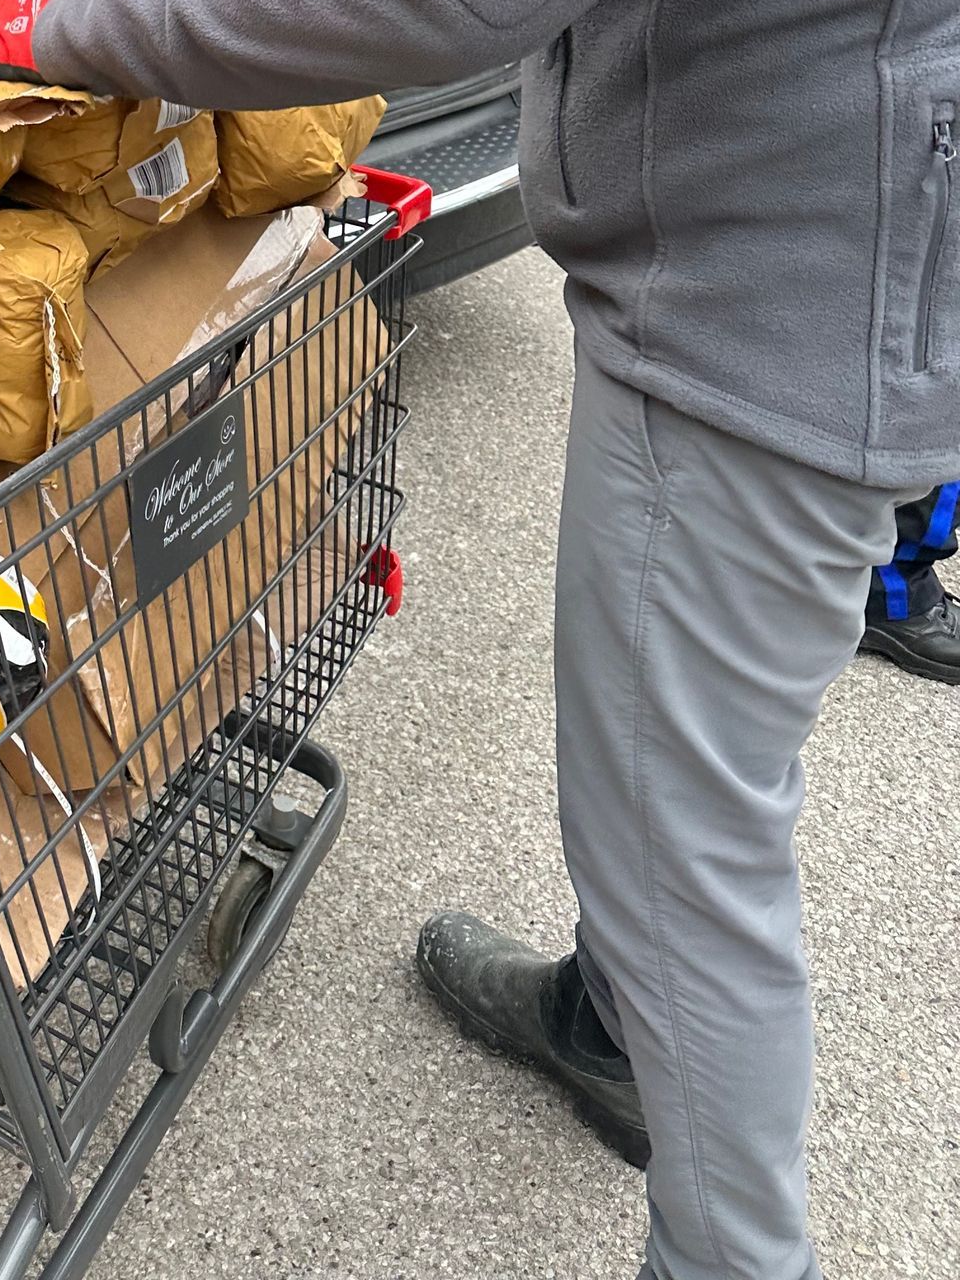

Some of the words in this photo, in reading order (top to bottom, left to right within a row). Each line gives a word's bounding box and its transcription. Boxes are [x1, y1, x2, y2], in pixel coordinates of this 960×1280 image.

[144, 457, 201, 521] Welcome
[163, 528, 182, 548] Thank
[179, 516, 192, 536] you
[197, 500, 212, 519] your
[210, 480, 235, 507] shopping
[179, 480, 202, 516] Our
[205, 447, 235, 492] Store
